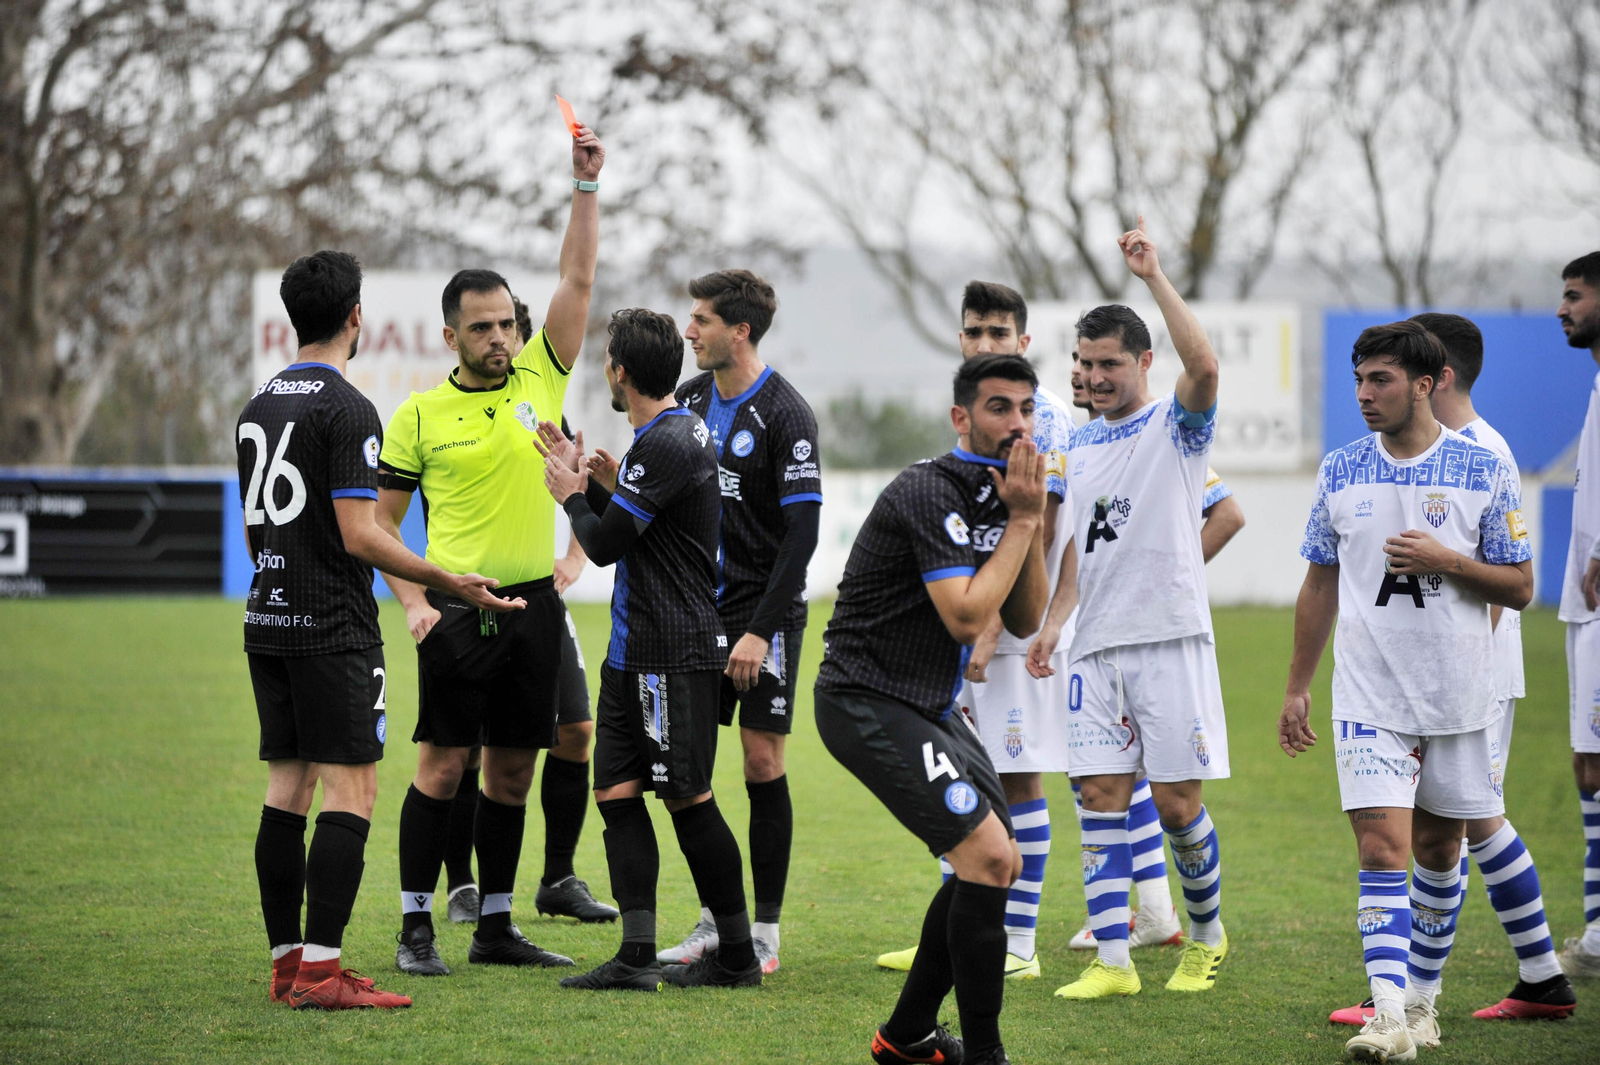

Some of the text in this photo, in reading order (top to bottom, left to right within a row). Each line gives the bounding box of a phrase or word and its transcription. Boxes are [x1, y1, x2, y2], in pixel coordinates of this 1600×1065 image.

[431, 439, 477, 453] matchapp
[239, 422, 307, 526] 26
[786, 462, 817, 472] RECAMBIOS
[784, 471, 800, 481] PACO
[249, 612, 291, 627] DEPORTIVO
[293, 615, 317, 627] F.C.
[922, 741, 960, 782] 4
[1354, 768, 1379, 776] VIDA
[1352, 810, 1388, 824] Carmen
